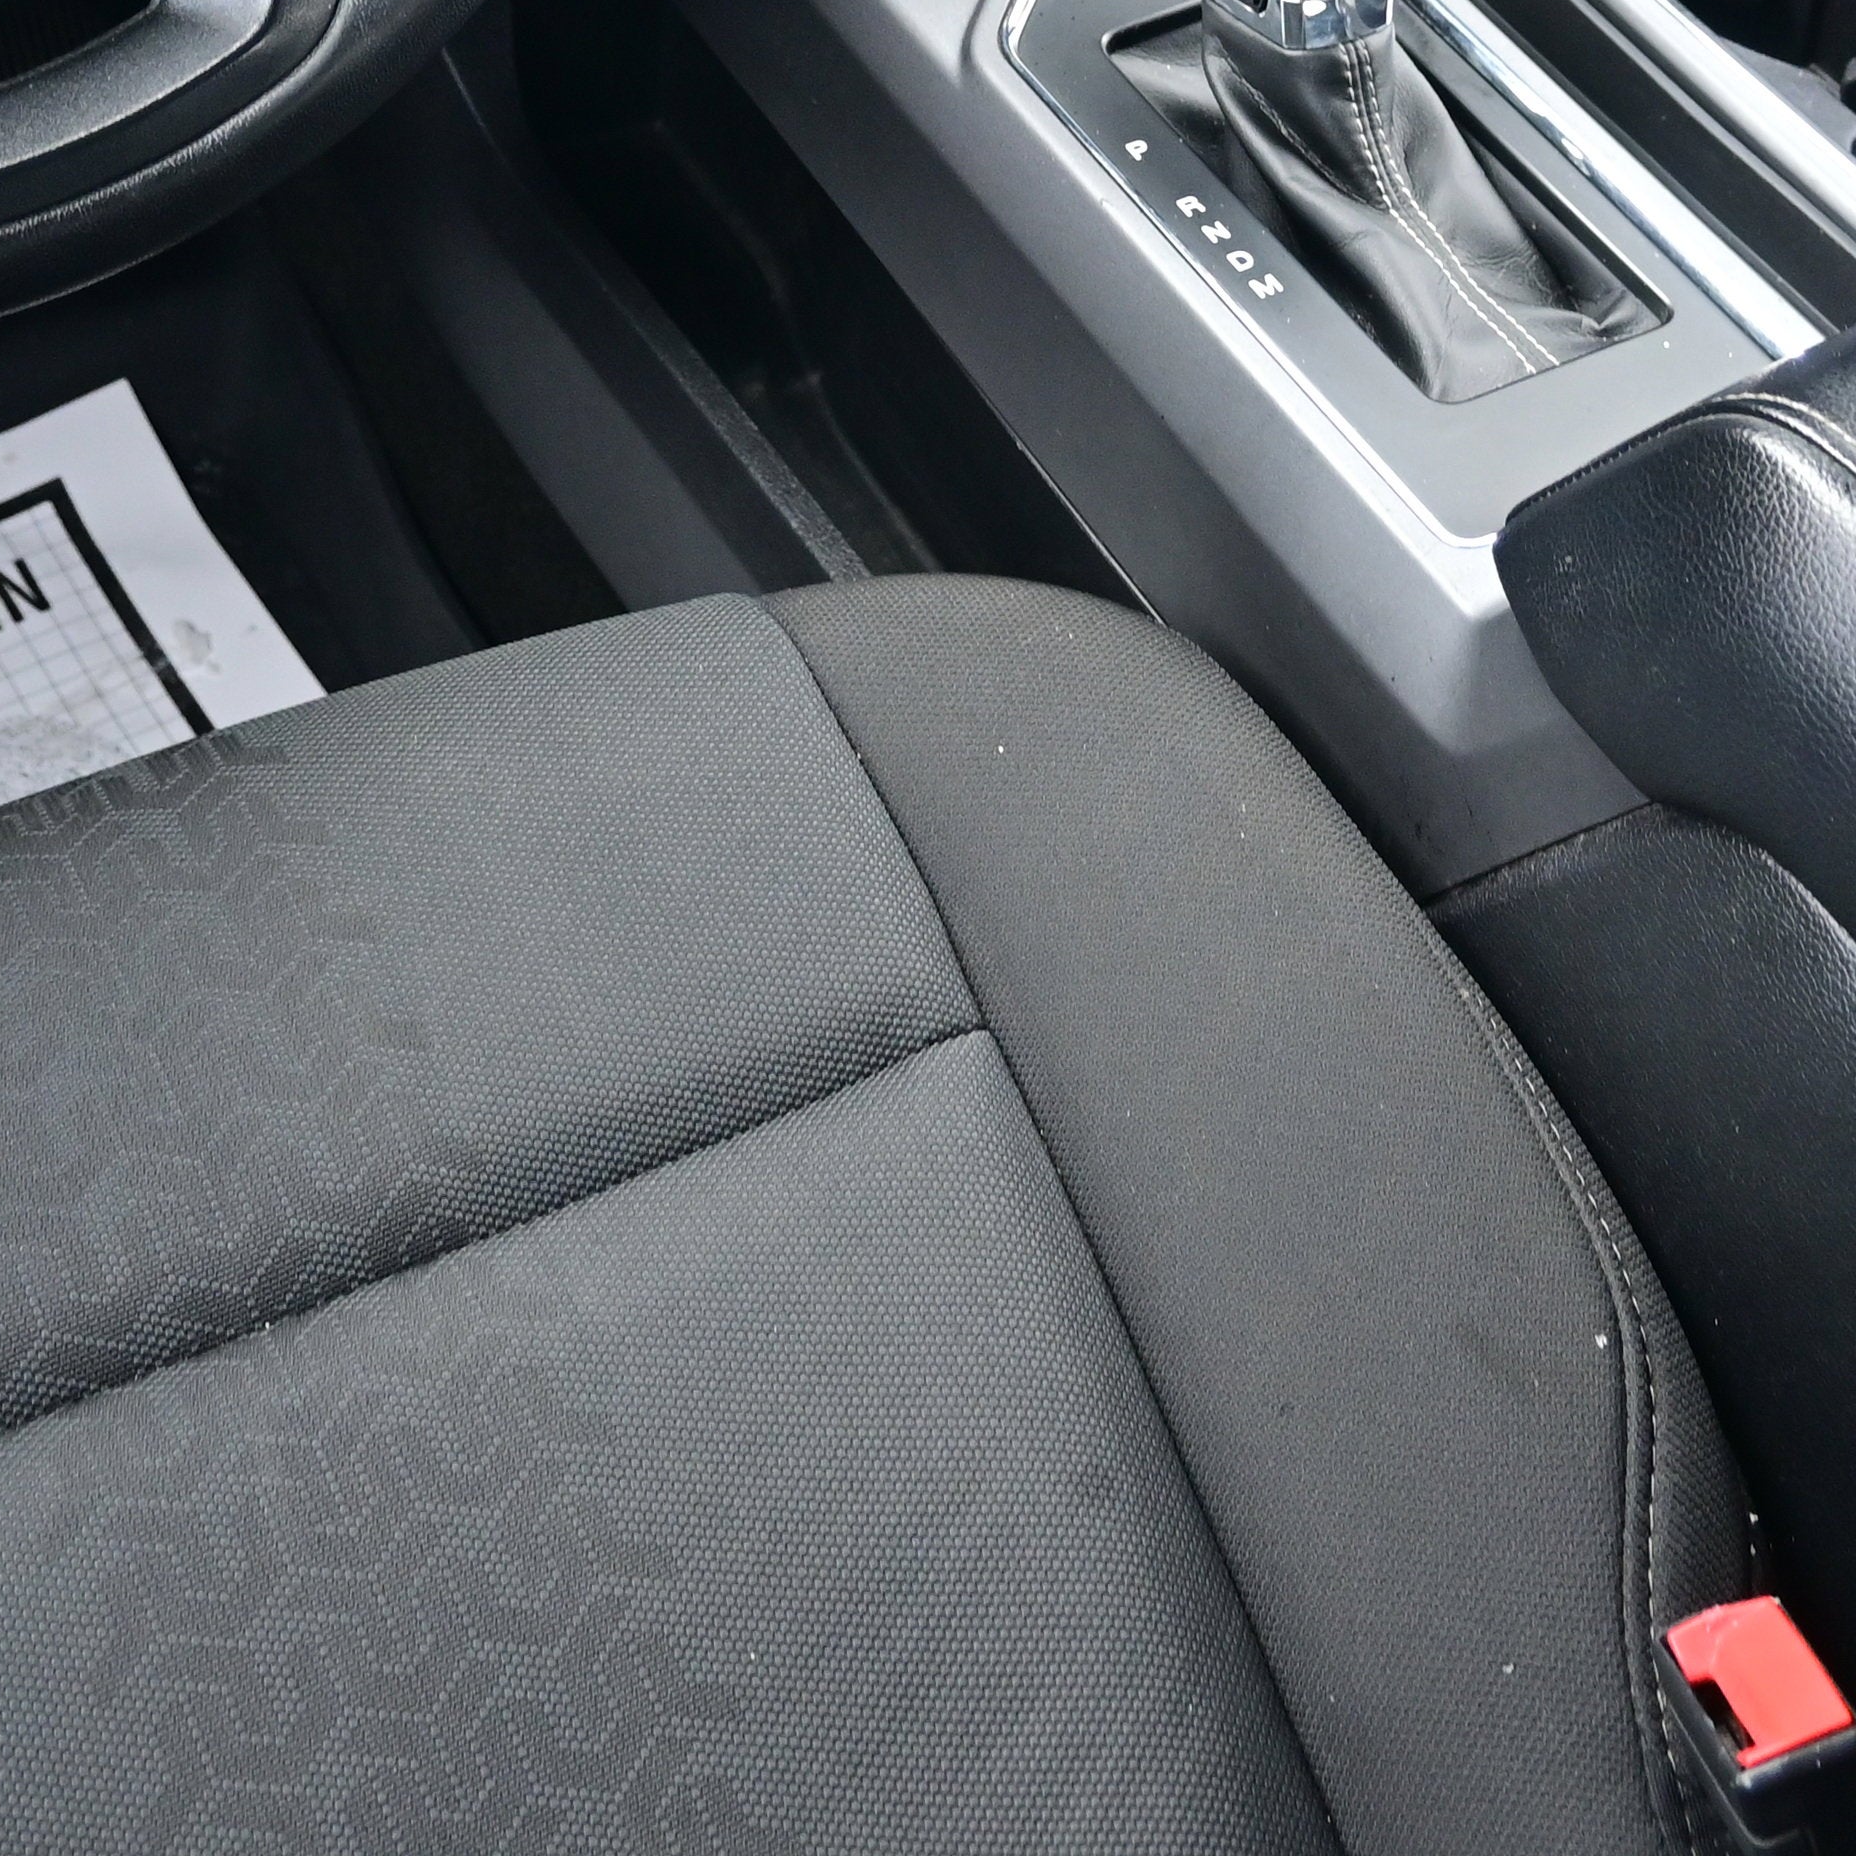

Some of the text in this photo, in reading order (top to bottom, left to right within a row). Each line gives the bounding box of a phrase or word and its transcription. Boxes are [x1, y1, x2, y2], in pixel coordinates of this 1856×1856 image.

[1125, 139, 1284, 300] P R N D M
